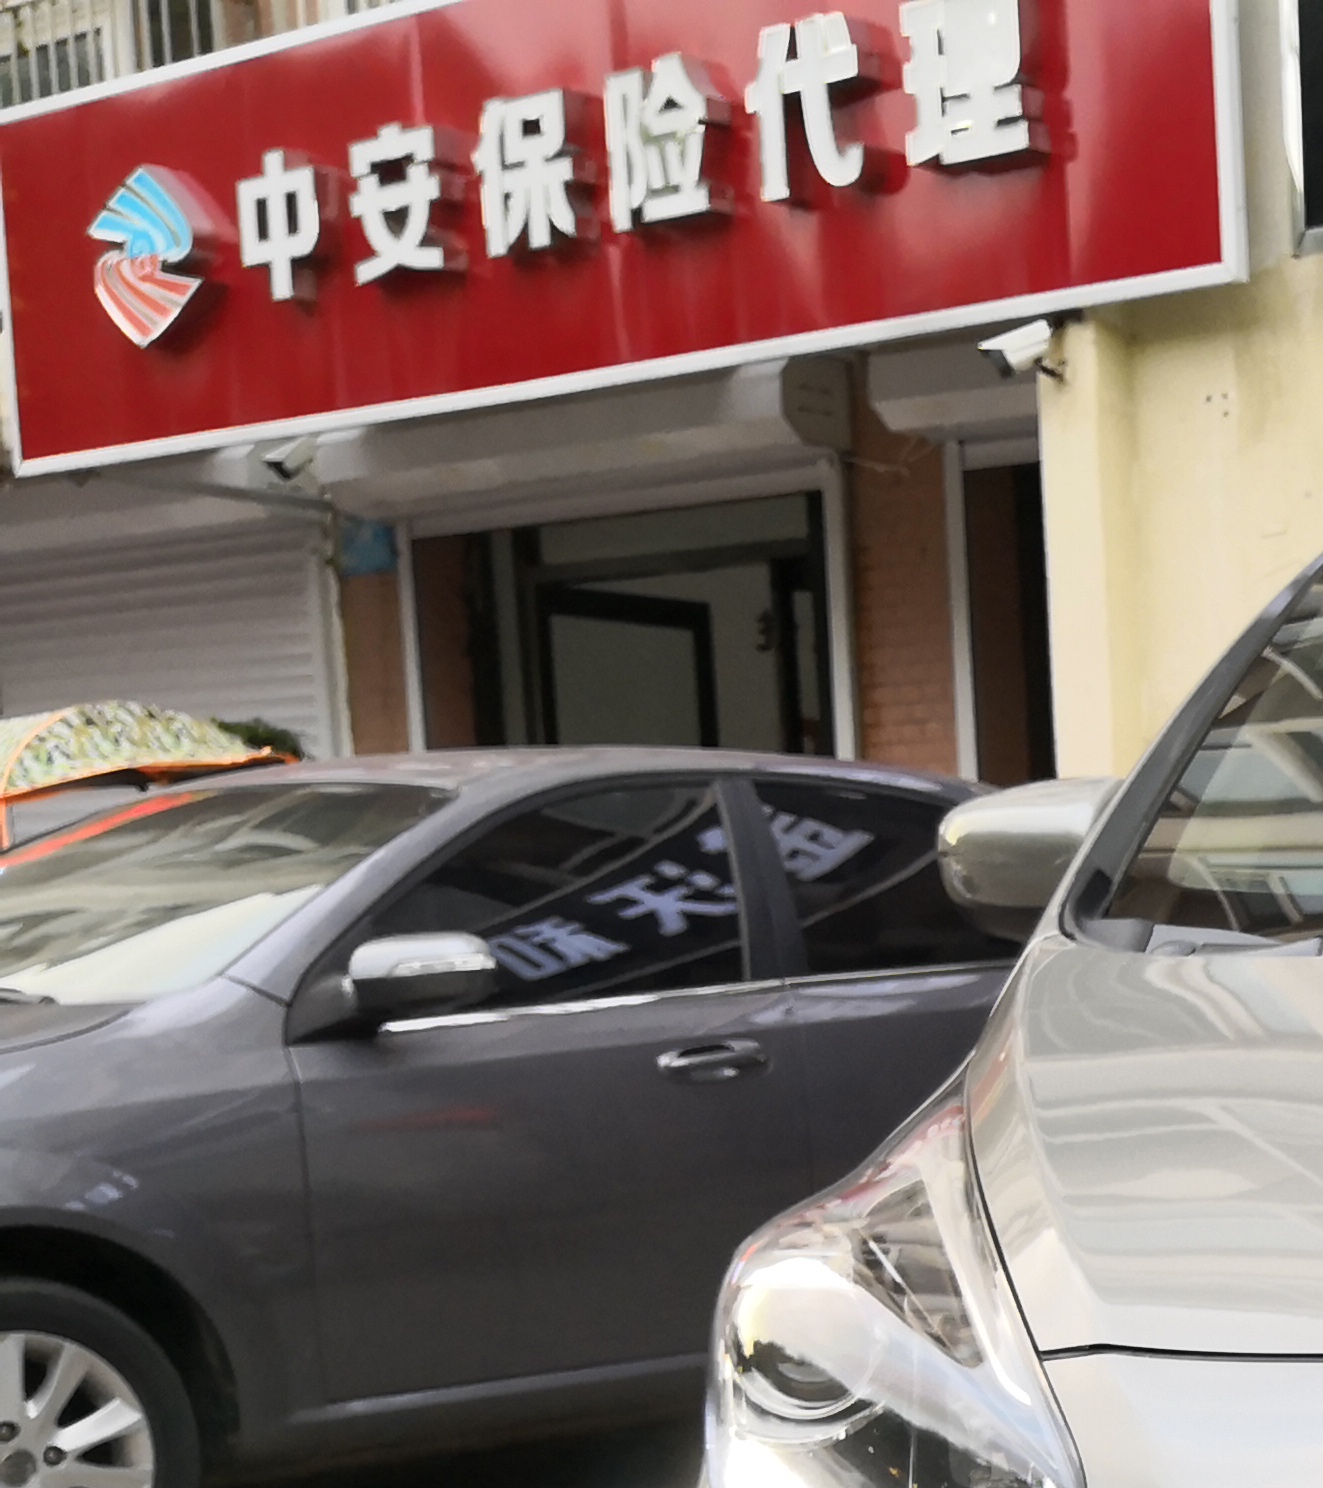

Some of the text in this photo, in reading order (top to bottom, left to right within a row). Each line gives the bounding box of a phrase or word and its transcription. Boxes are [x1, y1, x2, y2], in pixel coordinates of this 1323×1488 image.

[235, 0, 1032, 302] 中安保险代理
